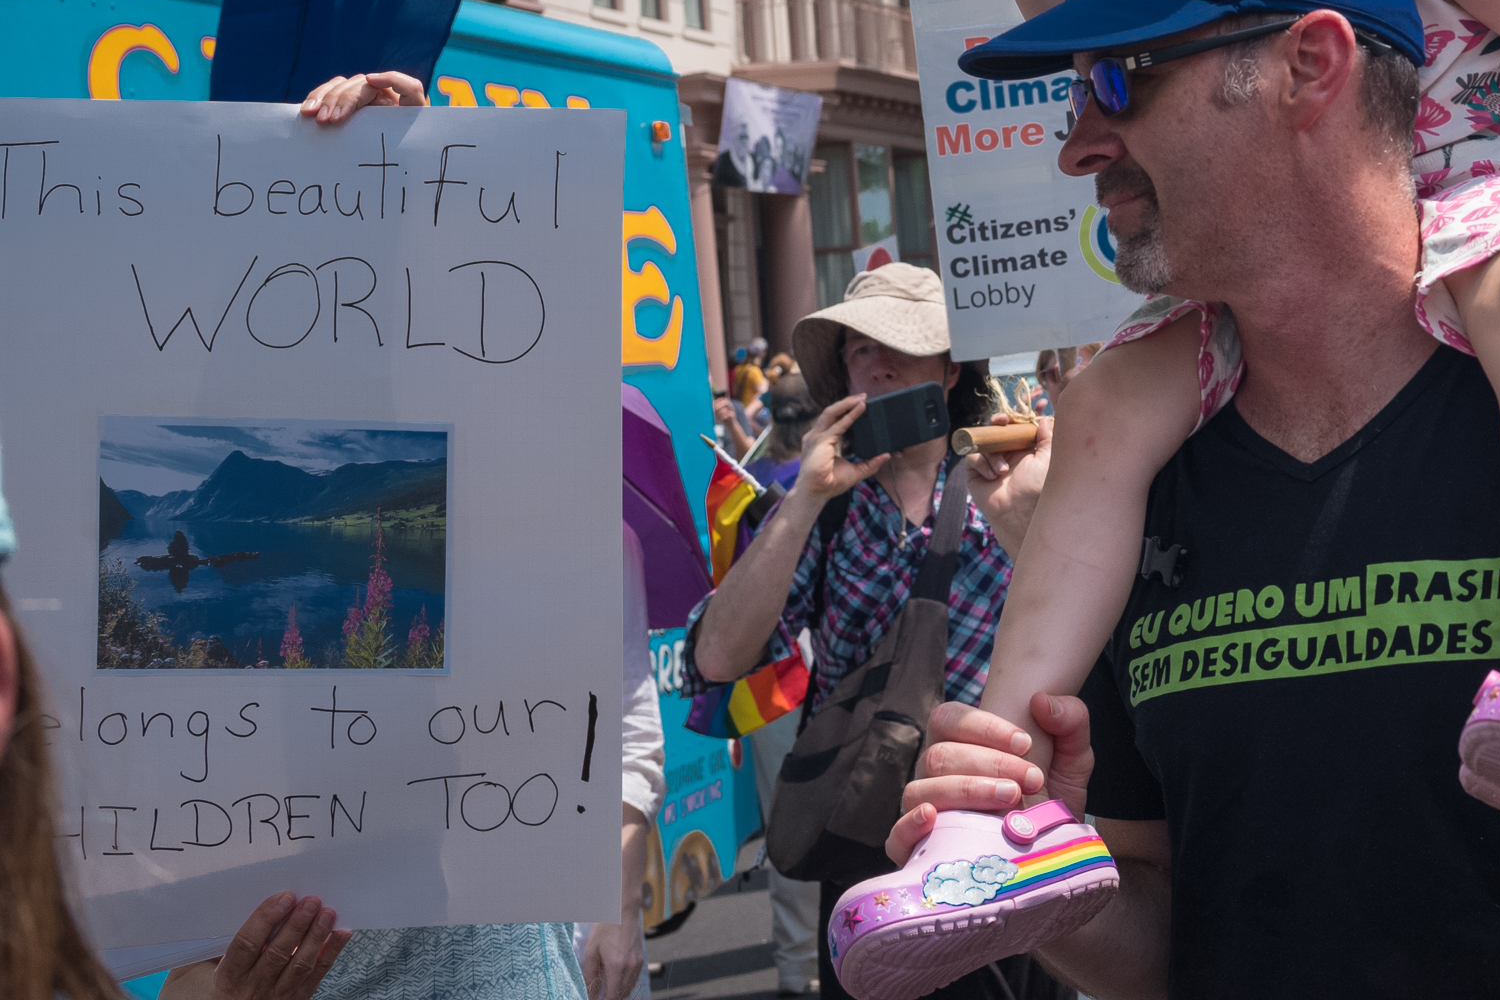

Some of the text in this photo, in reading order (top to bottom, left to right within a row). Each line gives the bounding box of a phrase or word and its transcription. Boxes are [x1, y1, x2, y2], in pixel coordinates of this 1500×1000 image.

[945, 73, 1084, 114] Clima
[935, 122, 1045, 156] More
[0, 140, 145, 220] This
[950, 248, 1068, 278] Climate
[953, 282, 1036, 310] Lobby
[131, 255, 546, 364] WORLD
[1129, 610, 1164, 649] EU
[1168, 584, 1284, 636] QUERO
[1295, 576, 1361, 618] UM
[1131, 619, 1493, 699] SEM DESIGUALDADES
[310, 684, 378, 750] to
[428, 698, 567, 745] our
[50, 790, 368, 860] HILDREN
